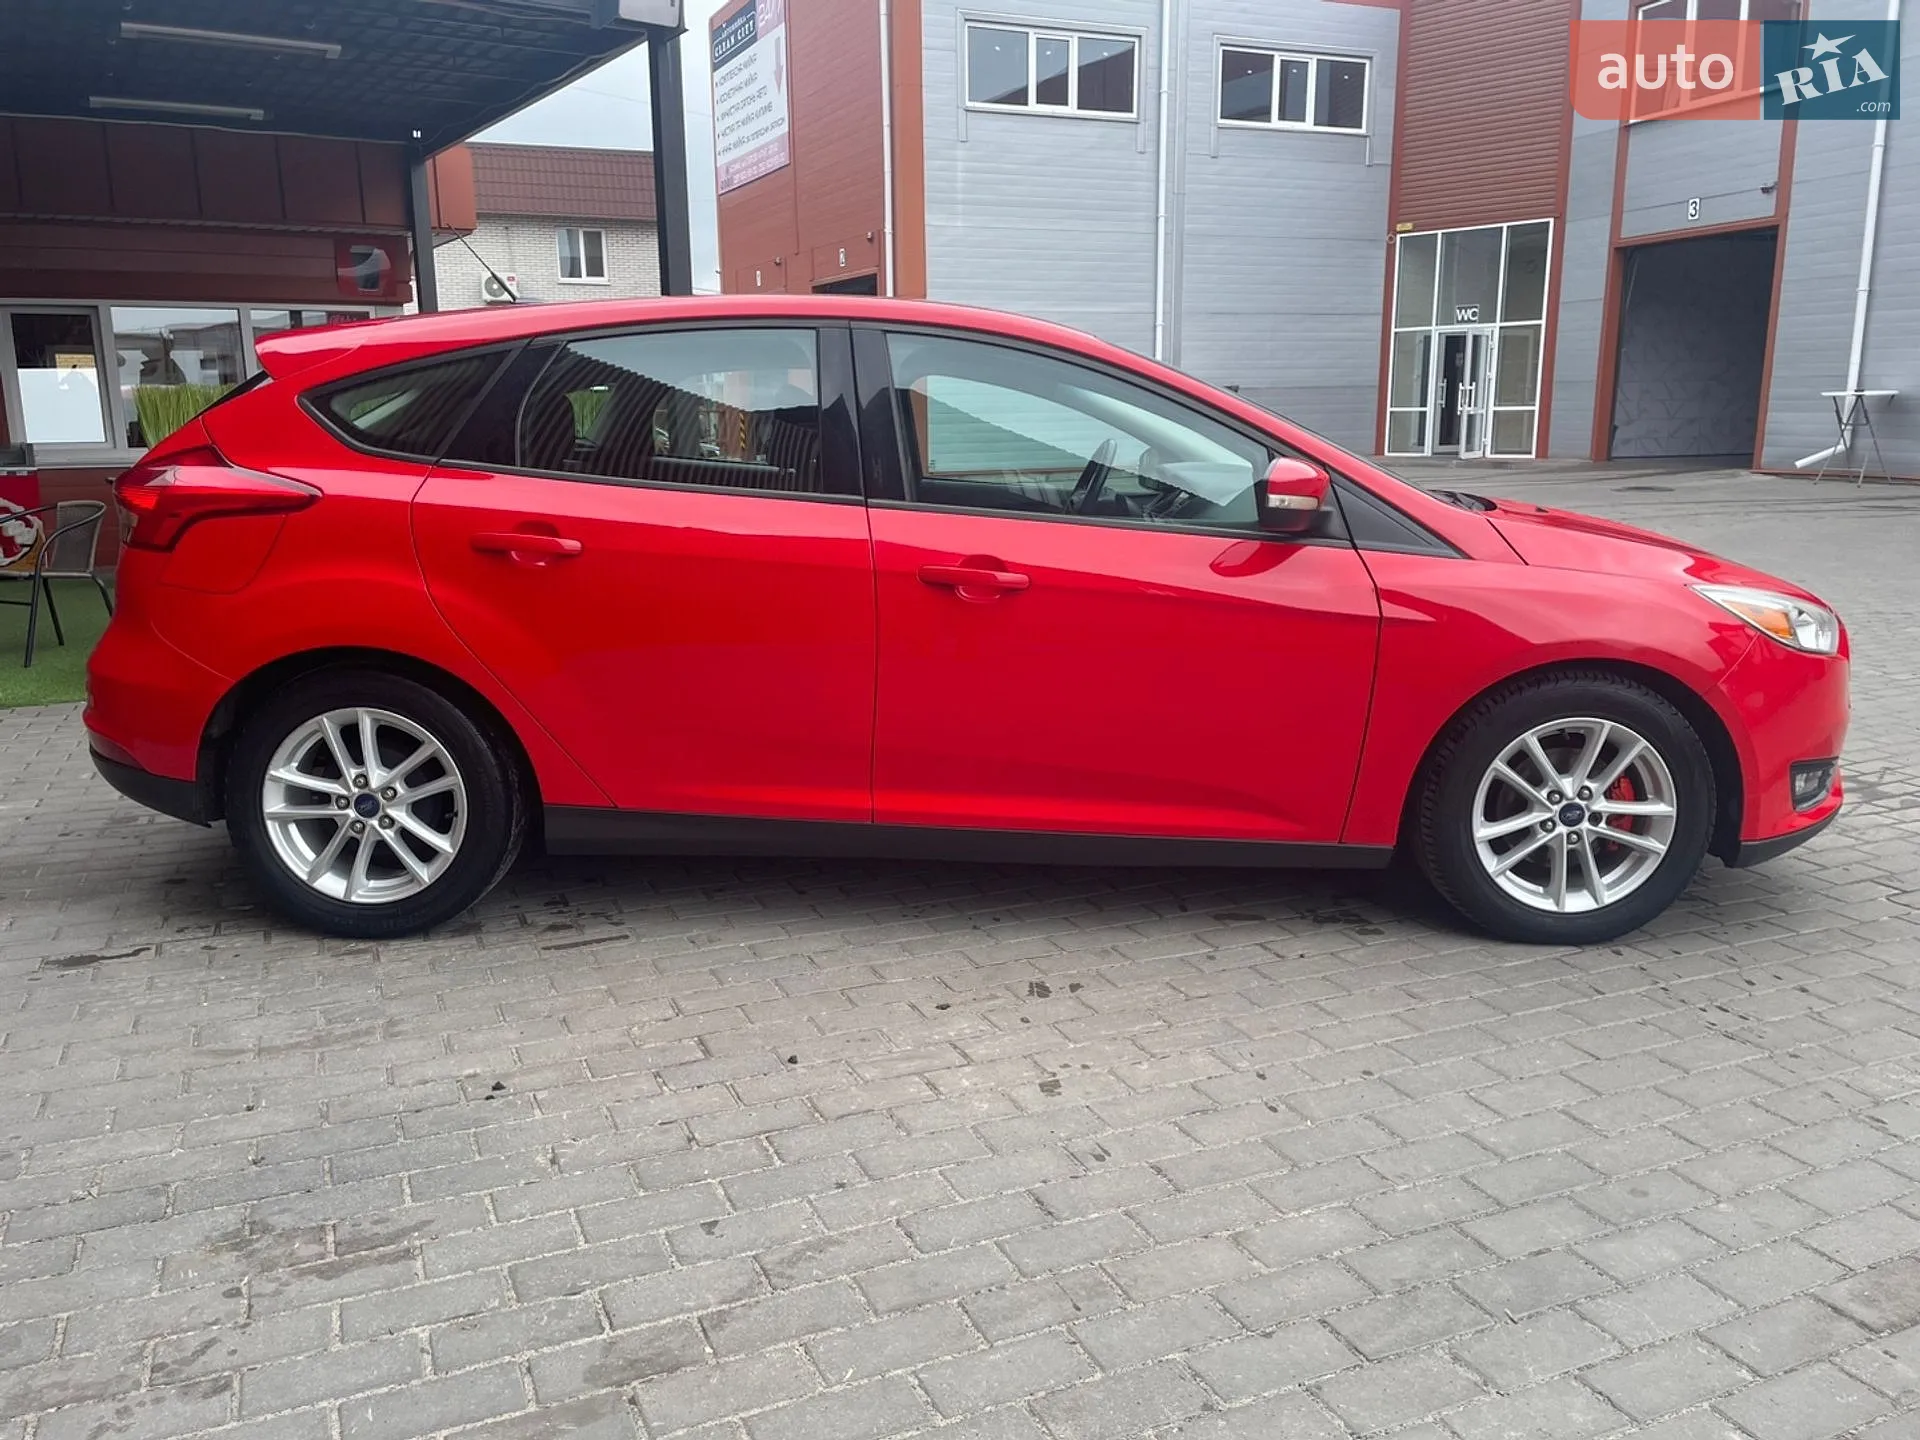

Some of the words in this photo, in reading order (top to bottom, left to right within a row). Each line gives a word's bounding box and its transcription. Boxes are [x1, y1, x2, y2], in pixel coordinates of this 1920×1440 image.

[714, 34, 736, 57] CLEAN
[1690, 201, 1697, 217] 3
[1456, 308, 1478, 321] WC
